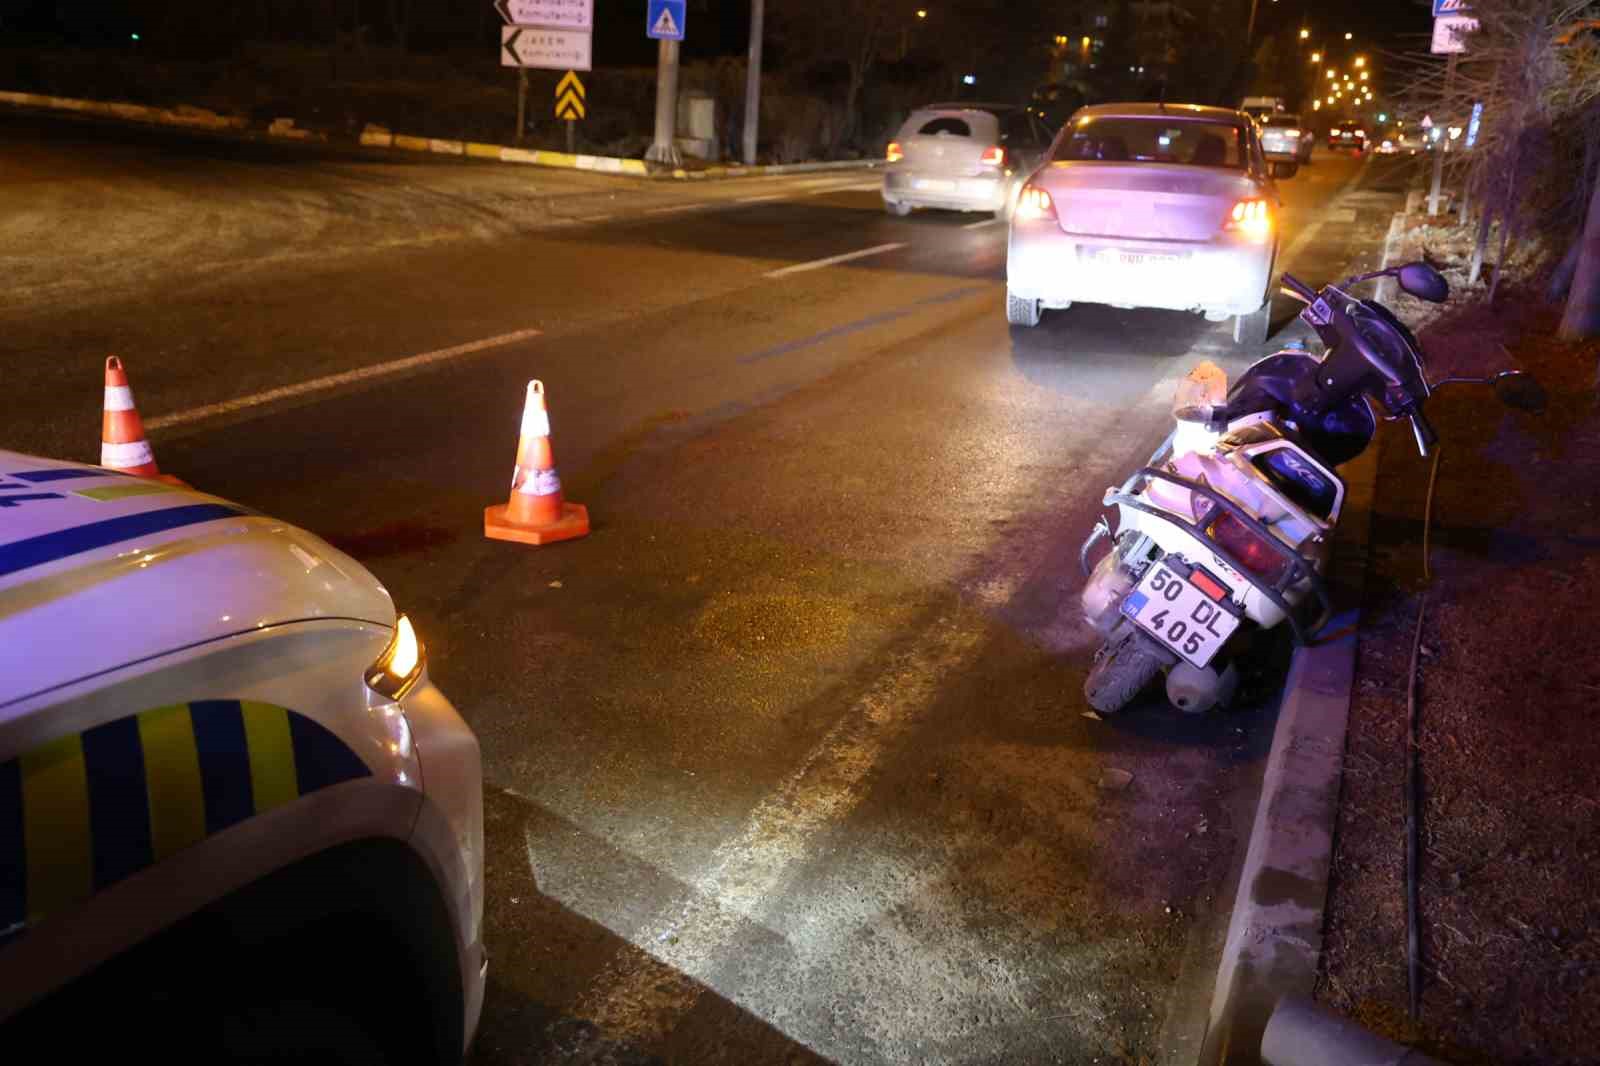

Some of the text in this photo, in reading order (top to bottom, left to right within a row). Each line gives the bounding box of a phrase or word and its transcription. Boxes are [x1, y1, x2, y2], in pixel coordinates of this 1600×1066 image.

[1150, 568, 1222, 638] 50 DL
[1150, 609, 1205, 655] 405
